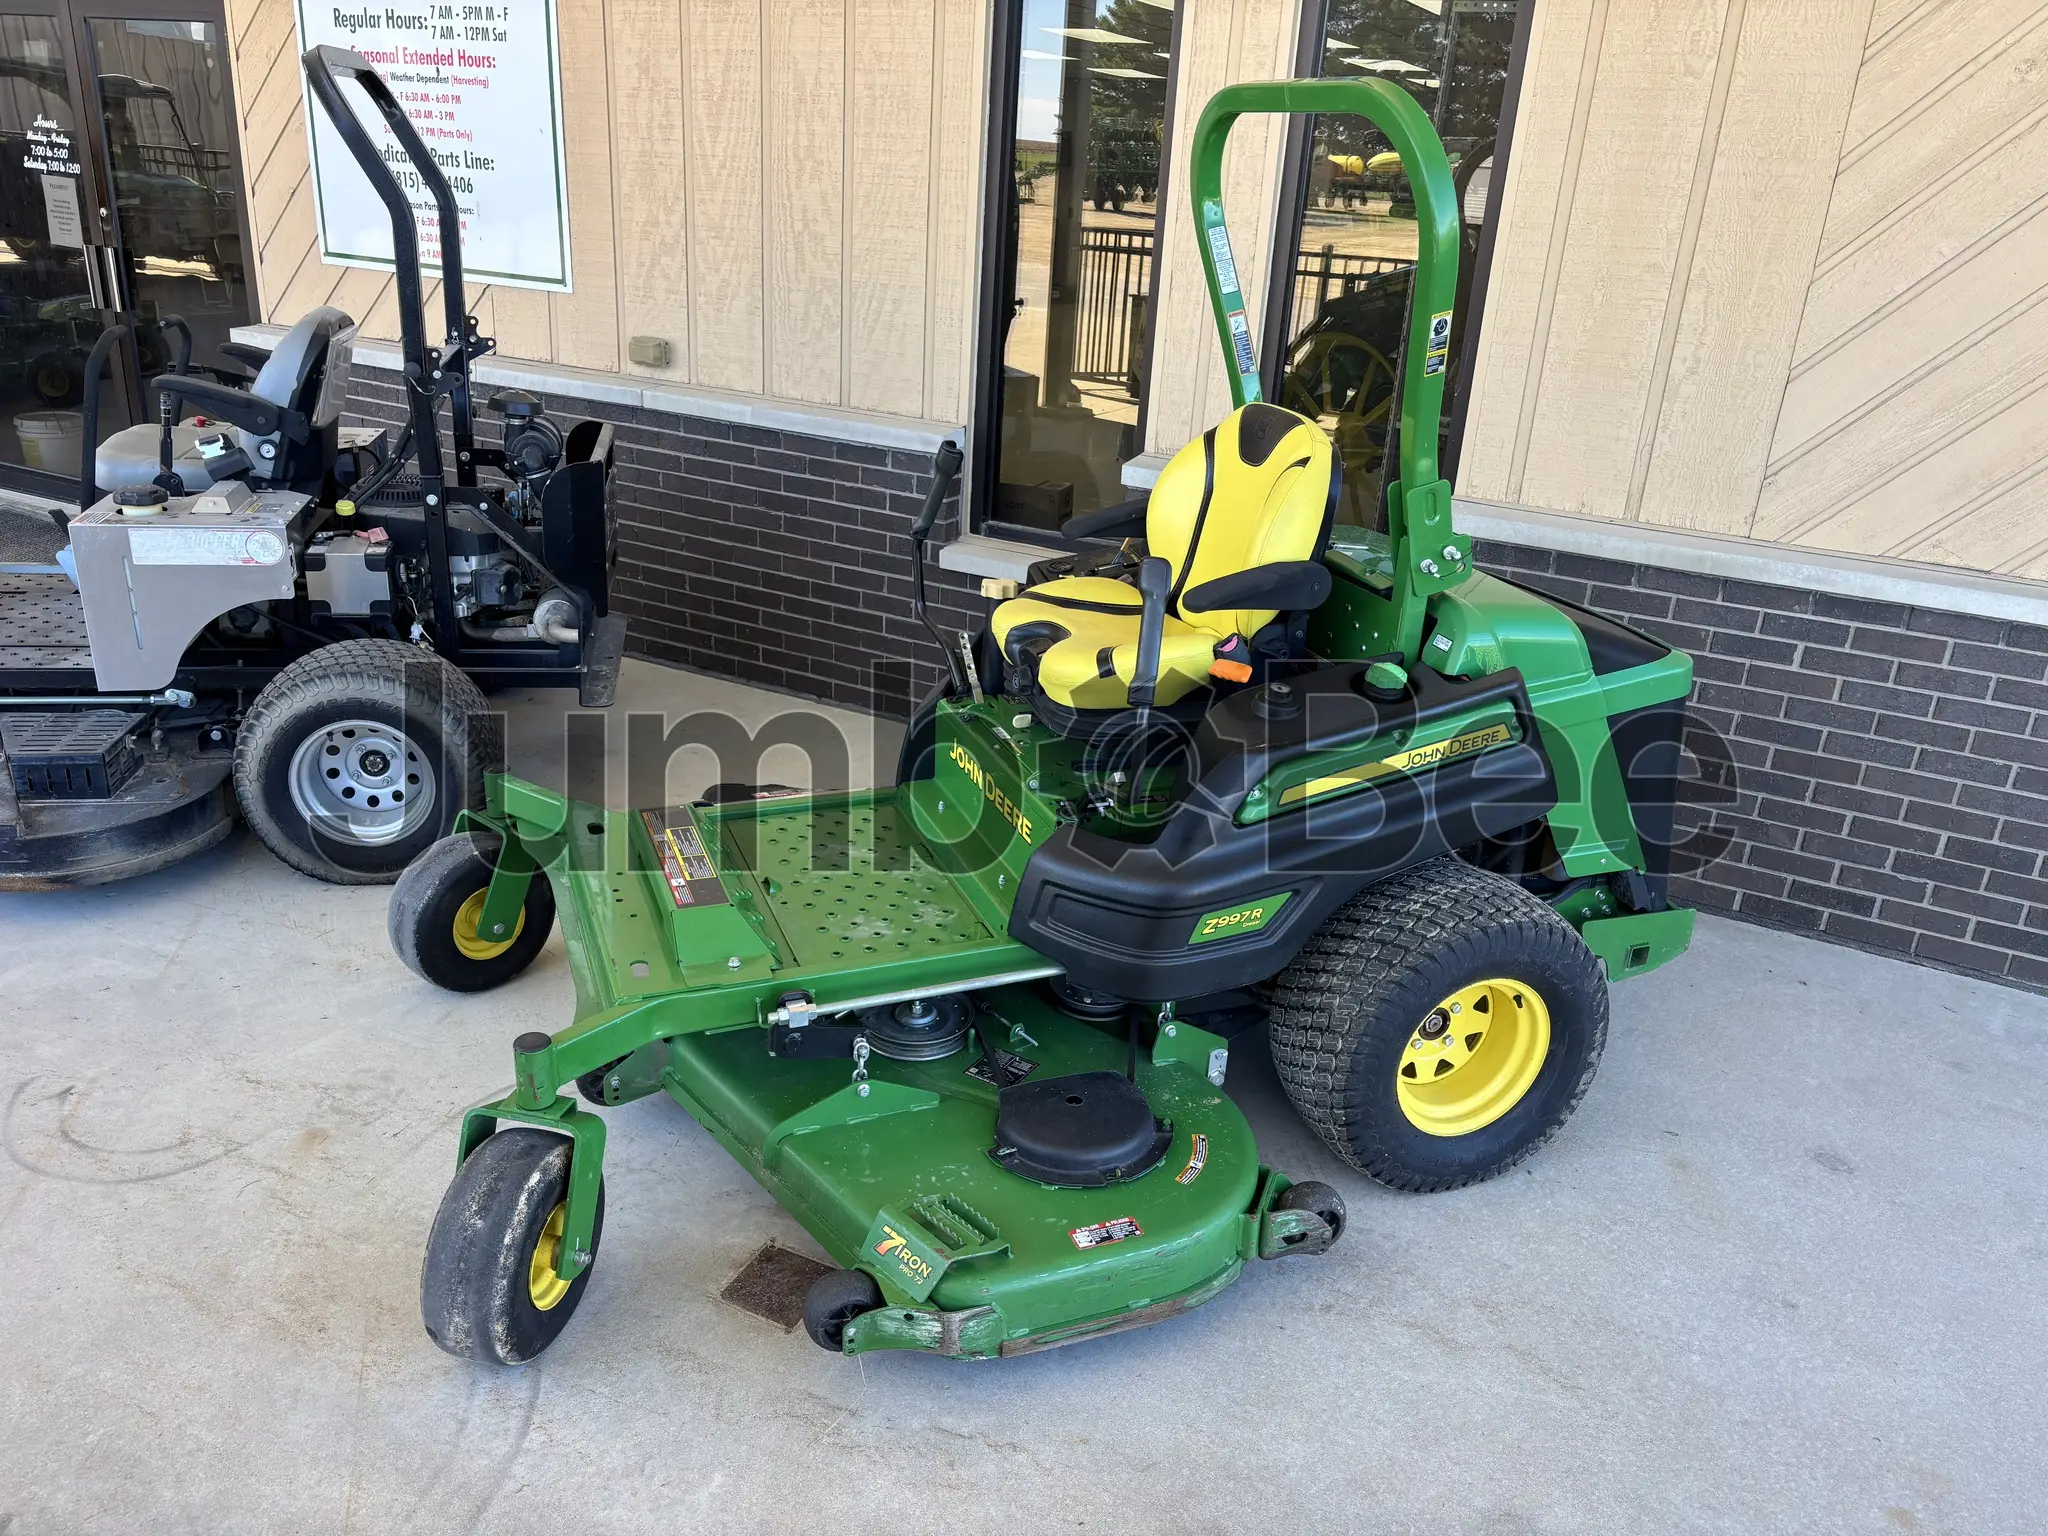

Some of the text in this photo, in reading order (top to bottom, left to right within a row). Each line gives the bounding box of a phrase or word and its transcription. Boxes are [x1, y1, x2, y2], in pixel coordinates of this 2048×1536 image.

[333, 7, 429, 33] Regular Hours:
[430, 5, 436, 20] 7
[438, 5, 453, 20] AM
[462, 6, 483, 21] 5PM
[485, 7, 495, 21] M
[503, 7, 509, 21] F
[431, 25, 437, 40] 7
[439, 25, 454, 40] AM
[464, 26, 490, 42] 12PM
[492, 27, 508, 42] Sat
[402, 46, 454, 67] Extended
[458, 49, 497, 69] Hours:
[390, 71, 415, 82] Weather
[416, 72, 450, 84] Dependent
[450, 74, 489, 89] (Harvesting)
[405, 92, 418, 102] 6:30
[420, 92, 430, 103] AM
[435, 93, 450, 104] 6:00
[451, 94, 462, 105] PM
[33, 114, 58, 129] Hours
[408, 109, 421, 119] 6:30
[423, 110, 434, 120] AM
[444, 111, 455, 121] PM
[26, 130, 47, 144] Monday
[51, 133, 70, 147] Friday
[425, 127, 436, 137] PM
[436, 128, 455, 140] (Parts
[455, 129, 473, 142] Only)
[31, 145, 45, 156] 7:00
[53, 148, 68, 159] 5:00
[430, 147, 461, 168] Parts
[463, 150, 494, 171] Line:
[23, 155, 48, 174] Saturday
[47, 160, 59, 171] 7:00
[66, 163, 80, 174] 12:00
[1402, 729, 1501, 769] JOHN DEERE
[949, 736, 983, 792] JOHN
[985, 770, 1033, 848] DEERE
[1201, 907, 1265, 936] Z997R
[874, 1224, 934, 1280] 7 IRON
[898, 1263, 924, 1286] PRO 72
